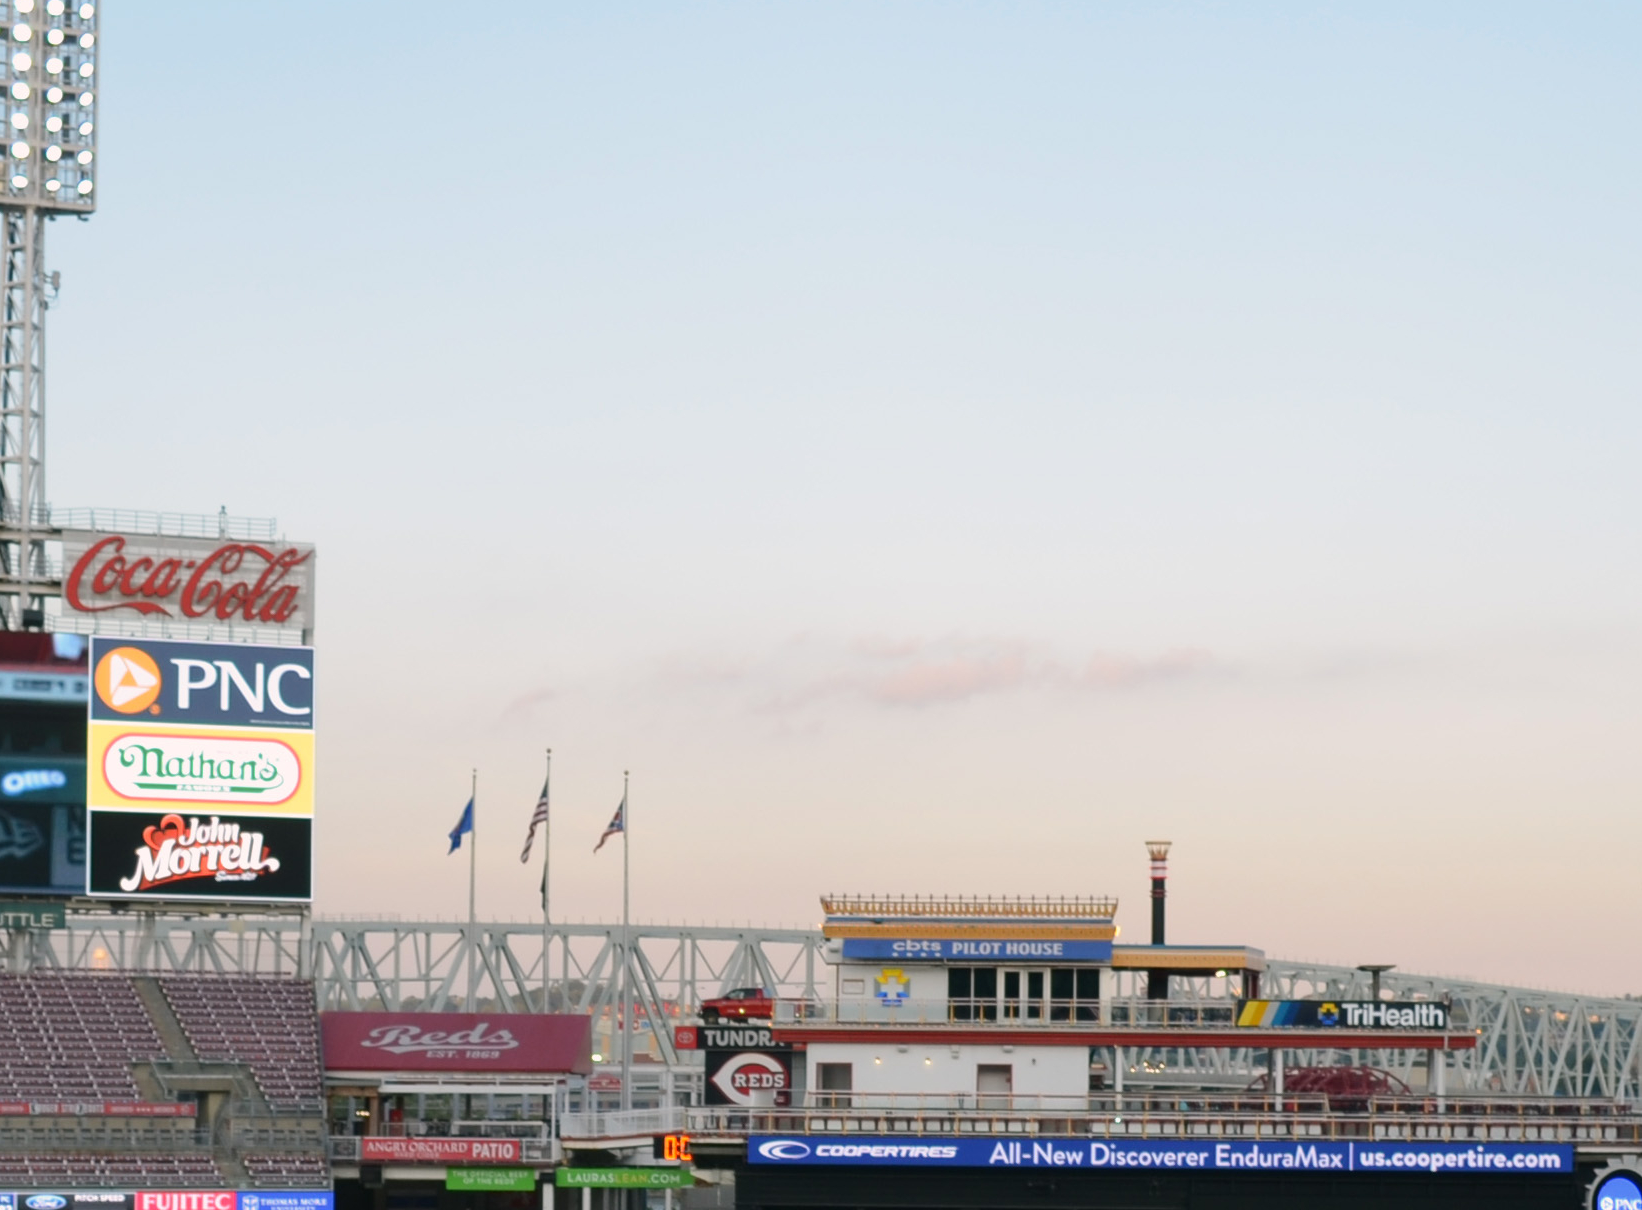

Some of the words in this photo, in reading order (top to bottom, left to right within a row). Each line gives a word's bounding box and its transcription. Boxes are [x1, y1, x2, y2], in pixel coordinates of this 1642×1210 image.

[65, 535, 314, 623] Coca-Cola
[170, 658, 312, 715] PNC
[119, 744, 283, 783] Nathan's
[179, 816, 240, 846] John
[120, 832, 281, 892] Morrell
[892, 939, 942, 954] cbts
[952, 942, 1000, 956] PILOT
[1006, 942, 1063, 956] HOUSE
[1341, 1002, 1444, 1028] TriHealth
[360, 1023, 519, 1054] Reds
[465, 1050, 500, 1059] 1869
[734, 1073, 785, 1088] REDS
[367, 1141, 407, 1153] ANGRY
[409, 1142, 468, 1153] ORCHARD
[473, 1143, 513, 1159] PATIO
[989, 1141, 1083, 1166] All-New
[1091, 1142, 1209, 1167] Discoverer
[1216, 1144, 1343, 1169] EnduraMax
[1360, 1147, 1561, 1173] us.coopertire.com
[568, 1173, 680, 1184] LAURASLEAN.COM
[300, 1198, 327, 1207] MORE
